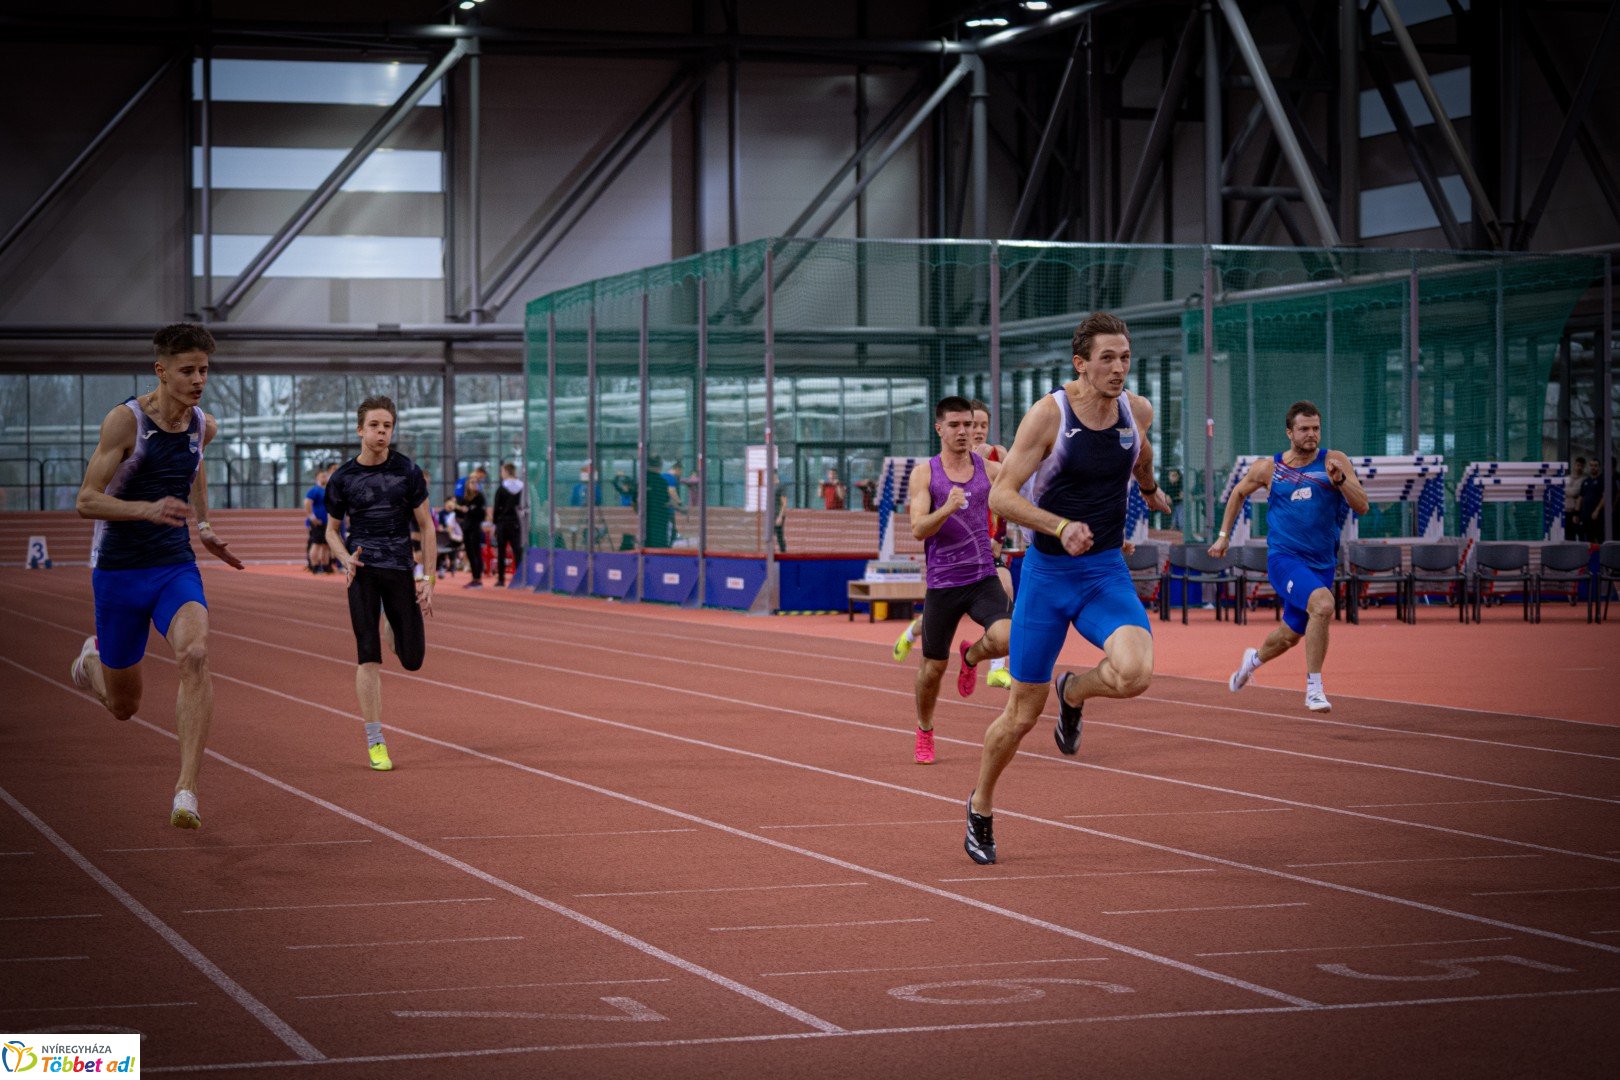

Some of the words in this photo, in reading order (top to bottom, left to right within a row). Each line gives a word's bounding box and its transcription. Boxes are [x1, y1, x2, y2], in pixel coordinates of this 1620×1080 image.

[31, 542, 45, 561] 3
[1316, 954, 1580, 982] 5
[886, 977, 1136, 1006] 6
